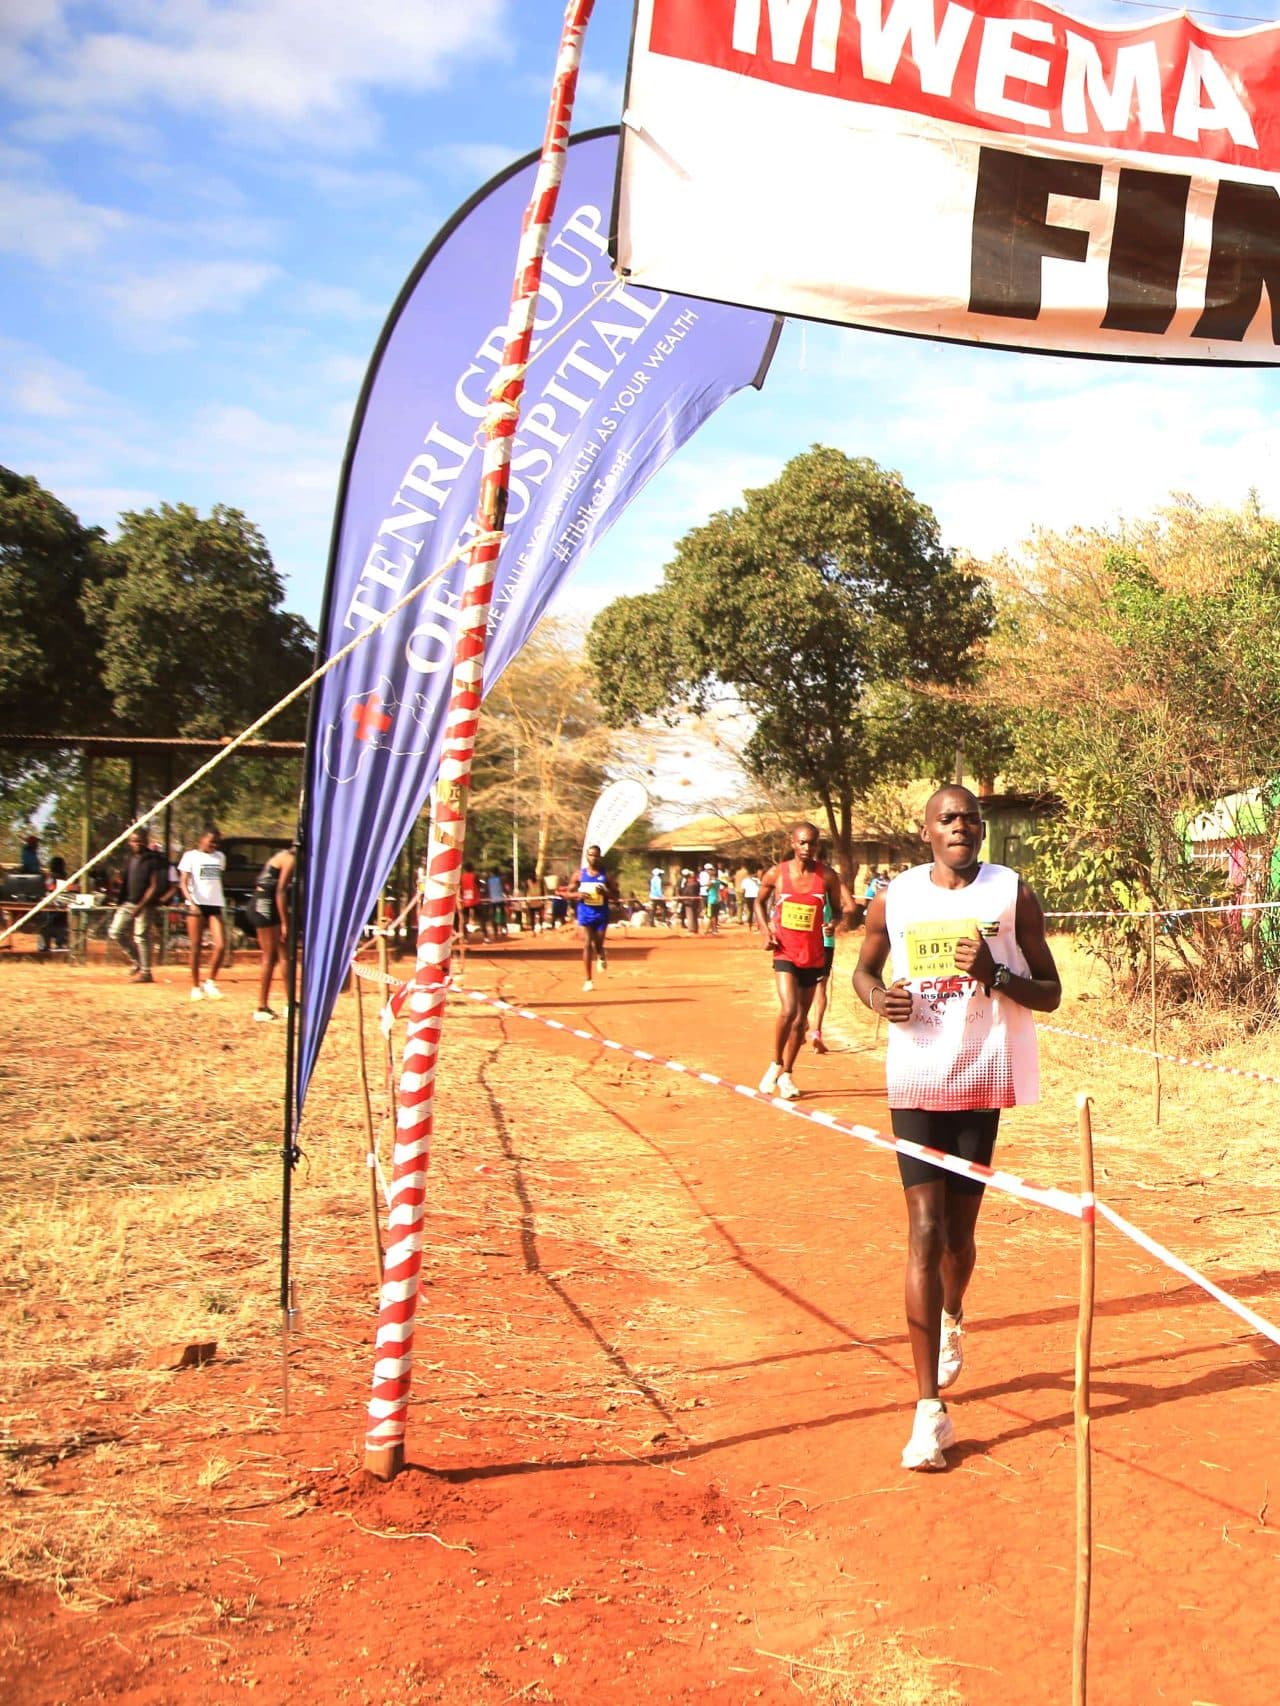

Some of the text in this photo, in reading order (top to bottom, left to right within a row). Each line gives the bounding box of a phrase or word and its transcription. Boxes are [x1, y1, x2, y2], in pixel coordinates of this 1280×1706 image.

[731, 0, 1260, 150] MWEMA
[594, 417, 618, 443] AS
[611, 370, 651, 414] YOUR
[643, 309, 700, 369] WEALTH
[343, 421, 477, 635] TENRI
[406, 577, 464, 673] OF
[919, 942, 953, 955] 805
